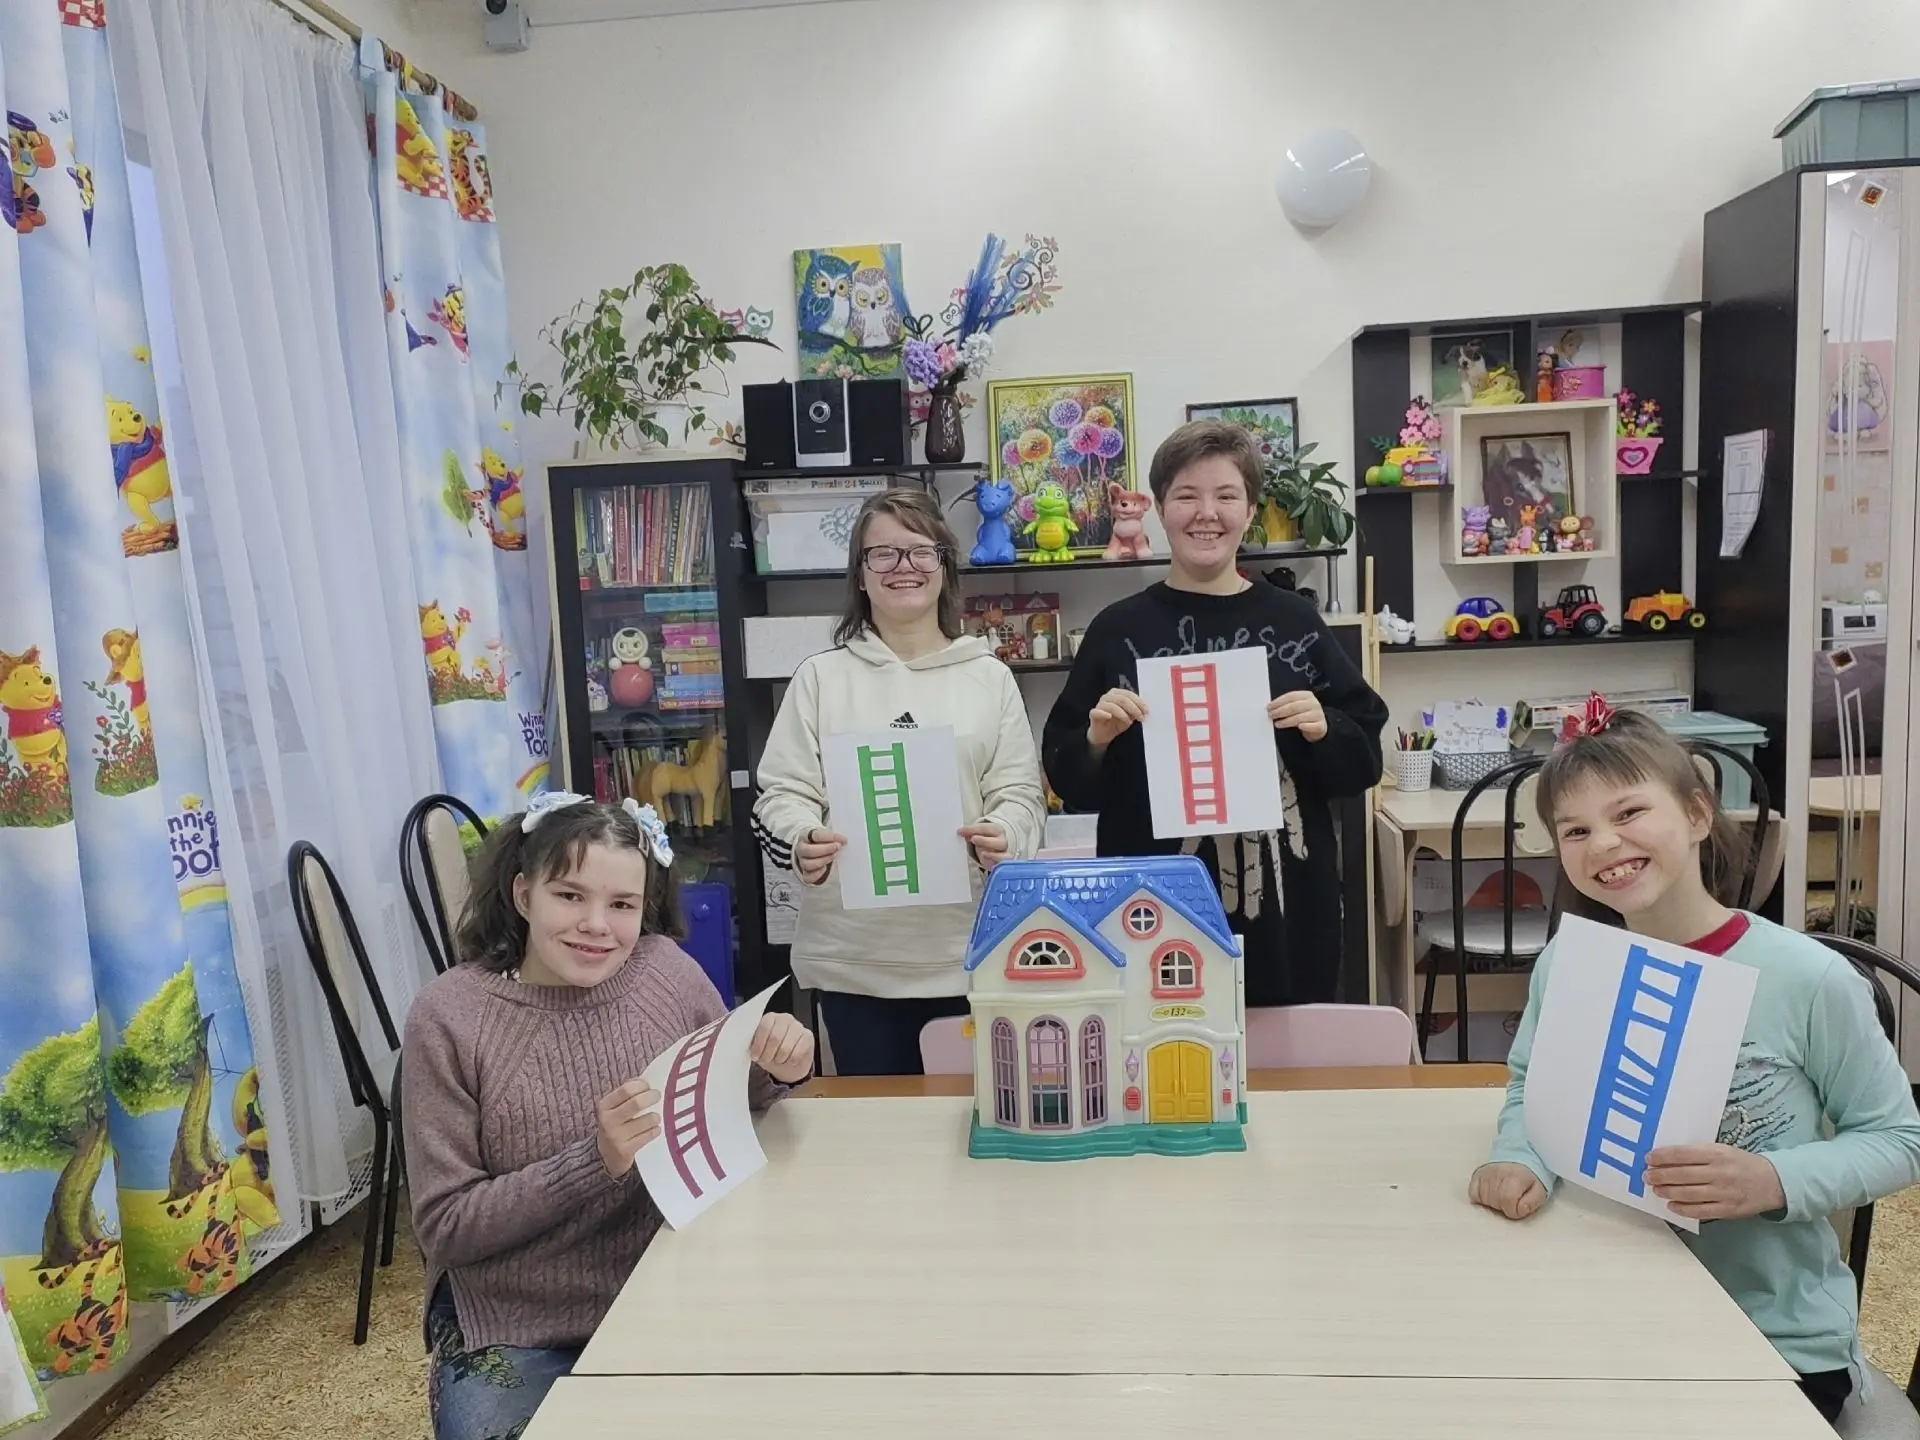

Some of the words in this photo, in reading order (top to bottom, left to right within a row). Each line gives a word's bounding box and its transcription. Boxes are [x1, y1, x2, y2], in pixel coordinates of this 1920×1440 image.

[167, 810, 217, 834] nnie
[169, 832, 204, 853] the
[1170, 1007, 1187, 1017] 132
